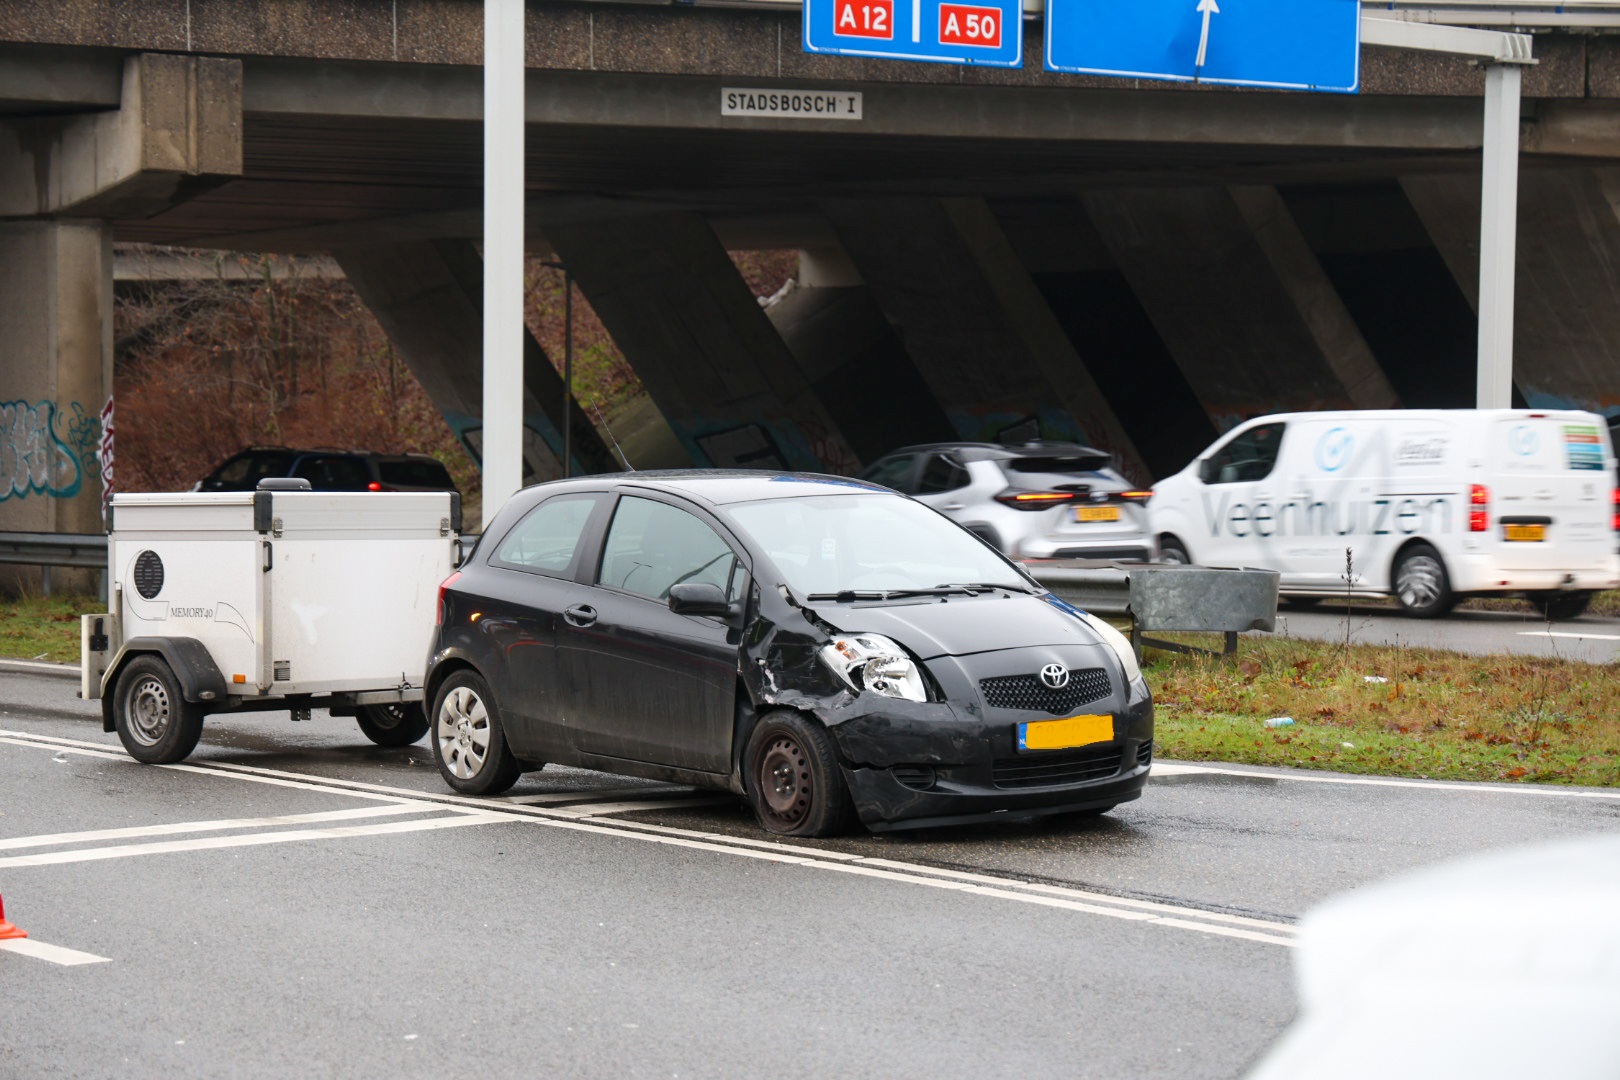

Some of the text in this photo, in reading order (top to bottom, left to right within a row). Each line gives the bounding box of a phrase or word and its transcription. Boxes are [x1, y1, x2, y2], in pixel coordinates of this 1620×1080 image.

[727, 92, 856, 113] STADSBOSCH I
[1200, 488, 1453, 537] Veenhuizen
